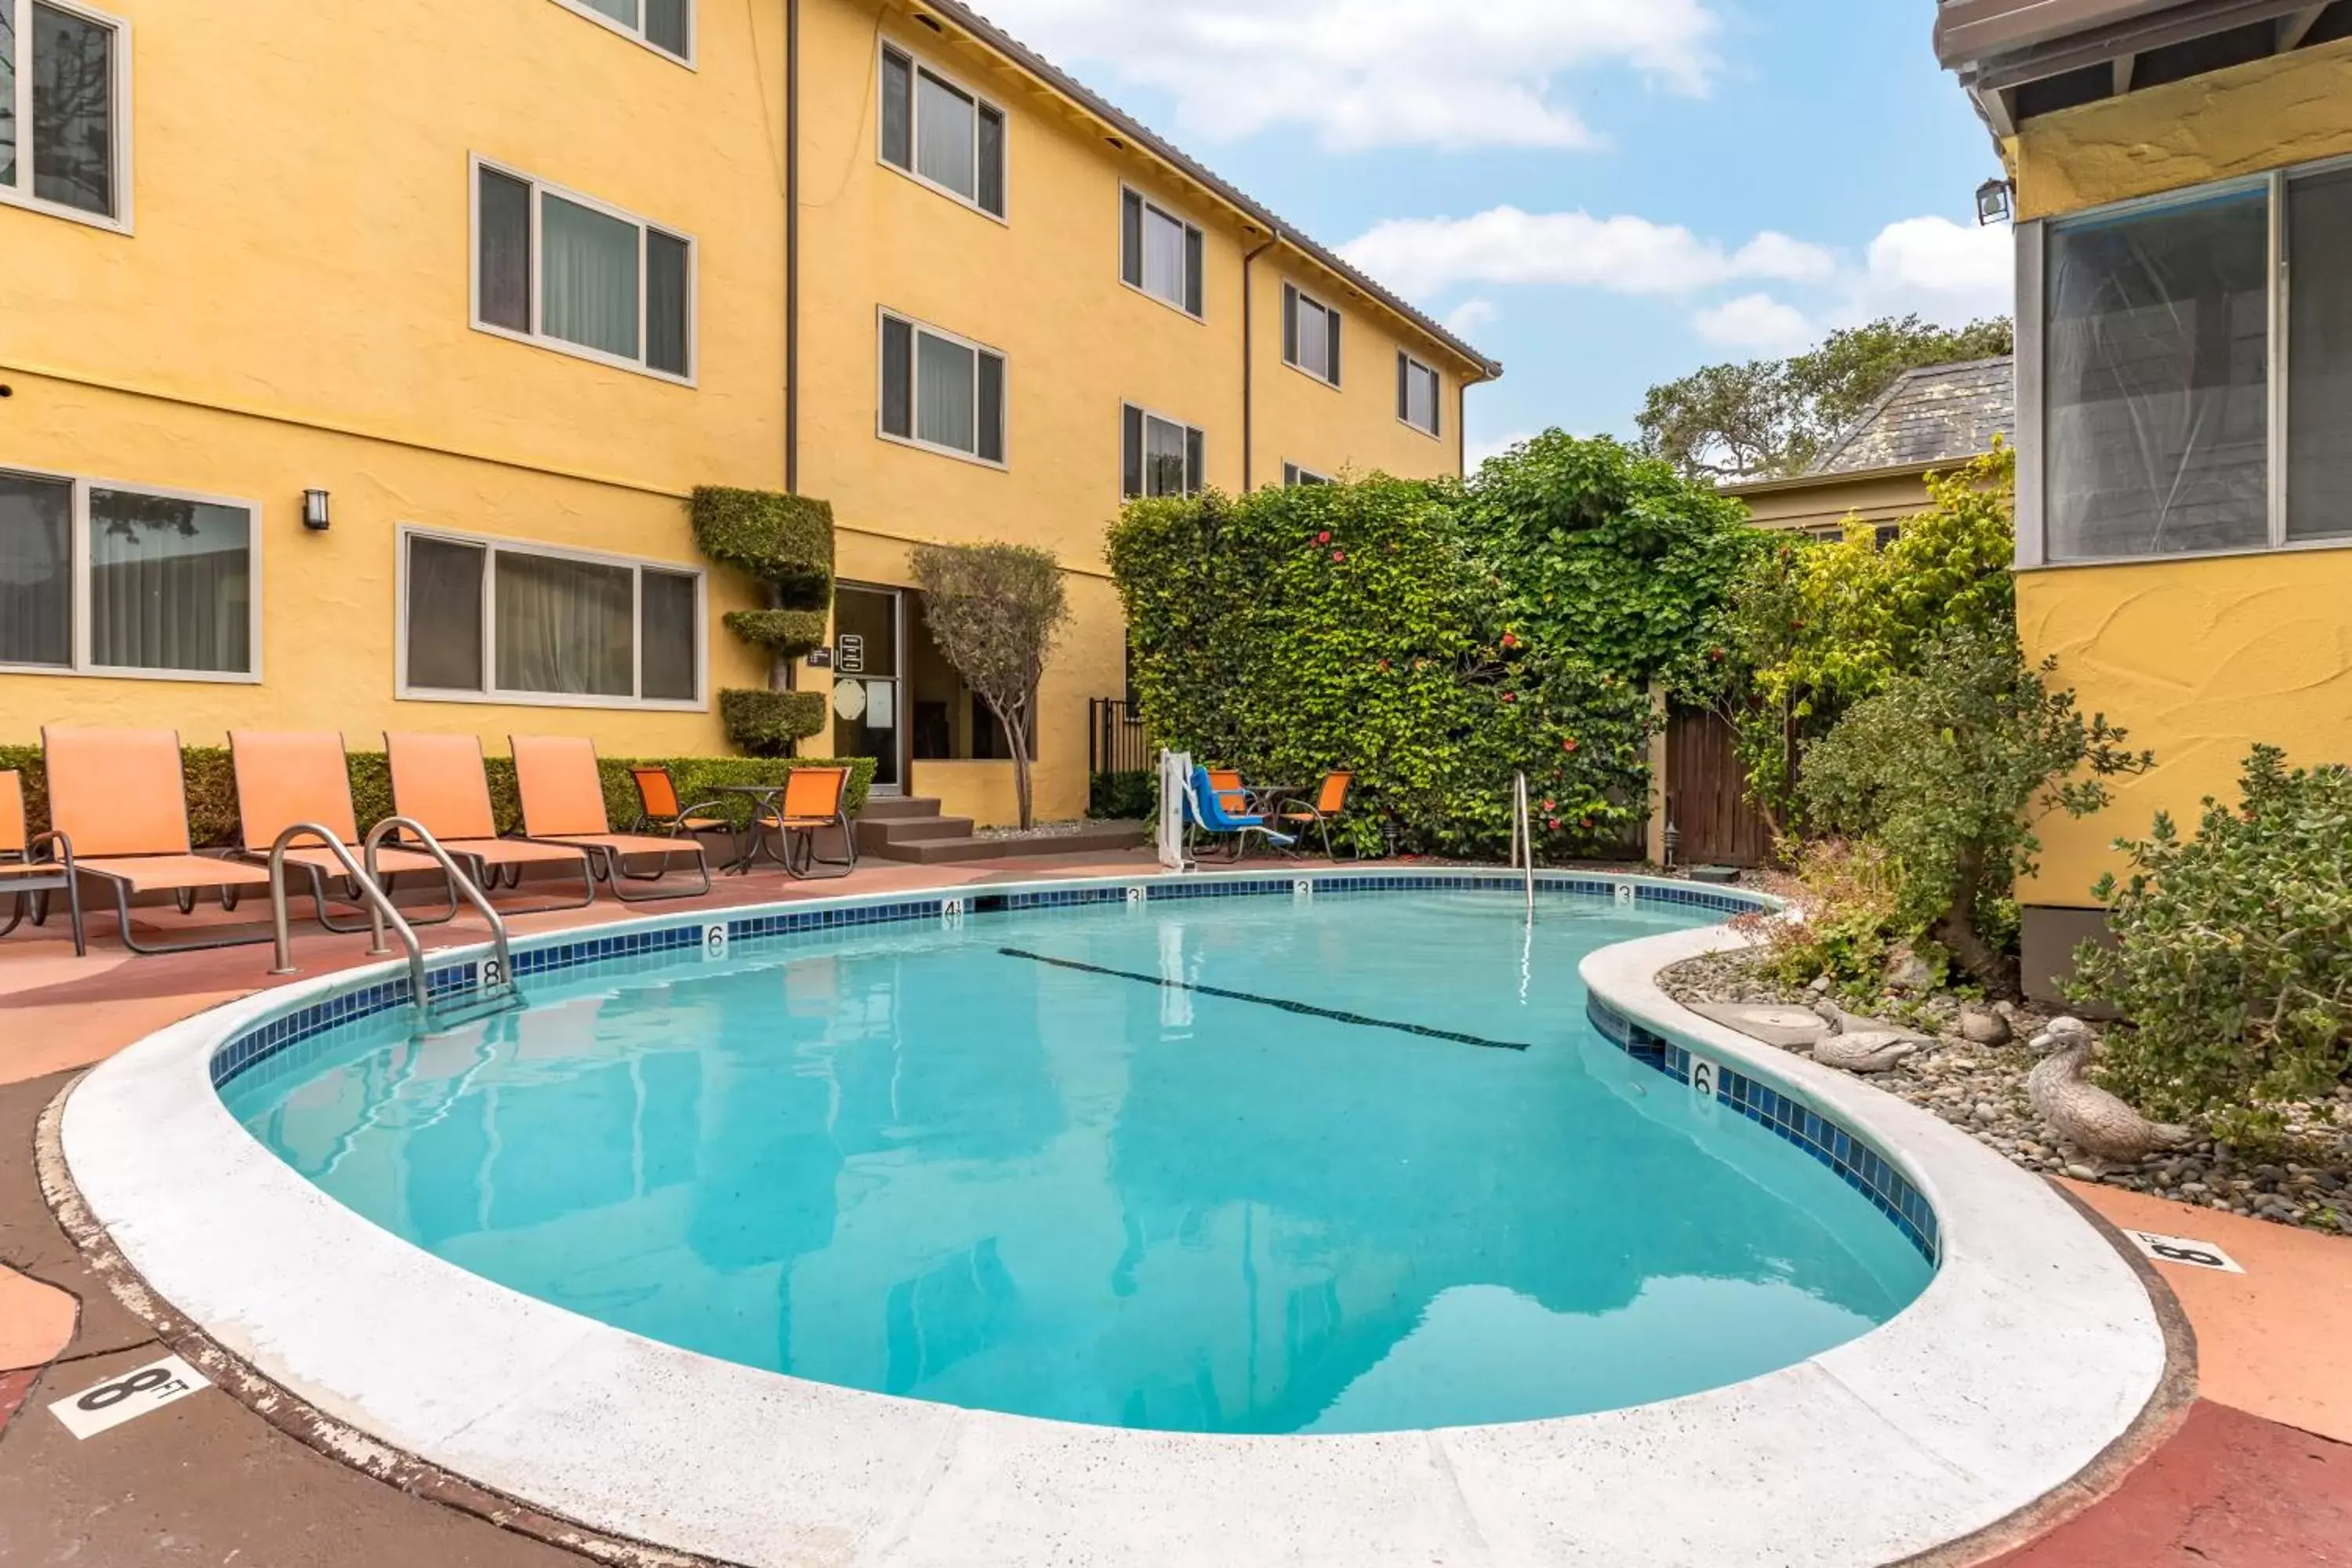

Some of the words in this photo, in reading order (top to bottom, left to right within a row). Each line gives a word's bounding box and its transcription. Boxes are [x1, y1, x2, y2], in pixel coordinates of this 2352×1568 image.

[708, 926, 723, 946] 6
[484, 960, 499, 986] 8
[1694, 1062, 1711, 1094] 6
[2151, 1244, 2224, 1266] 8
[77, 1368, 172, 1412] 8
[150, 1378, 190, 1399] FT
